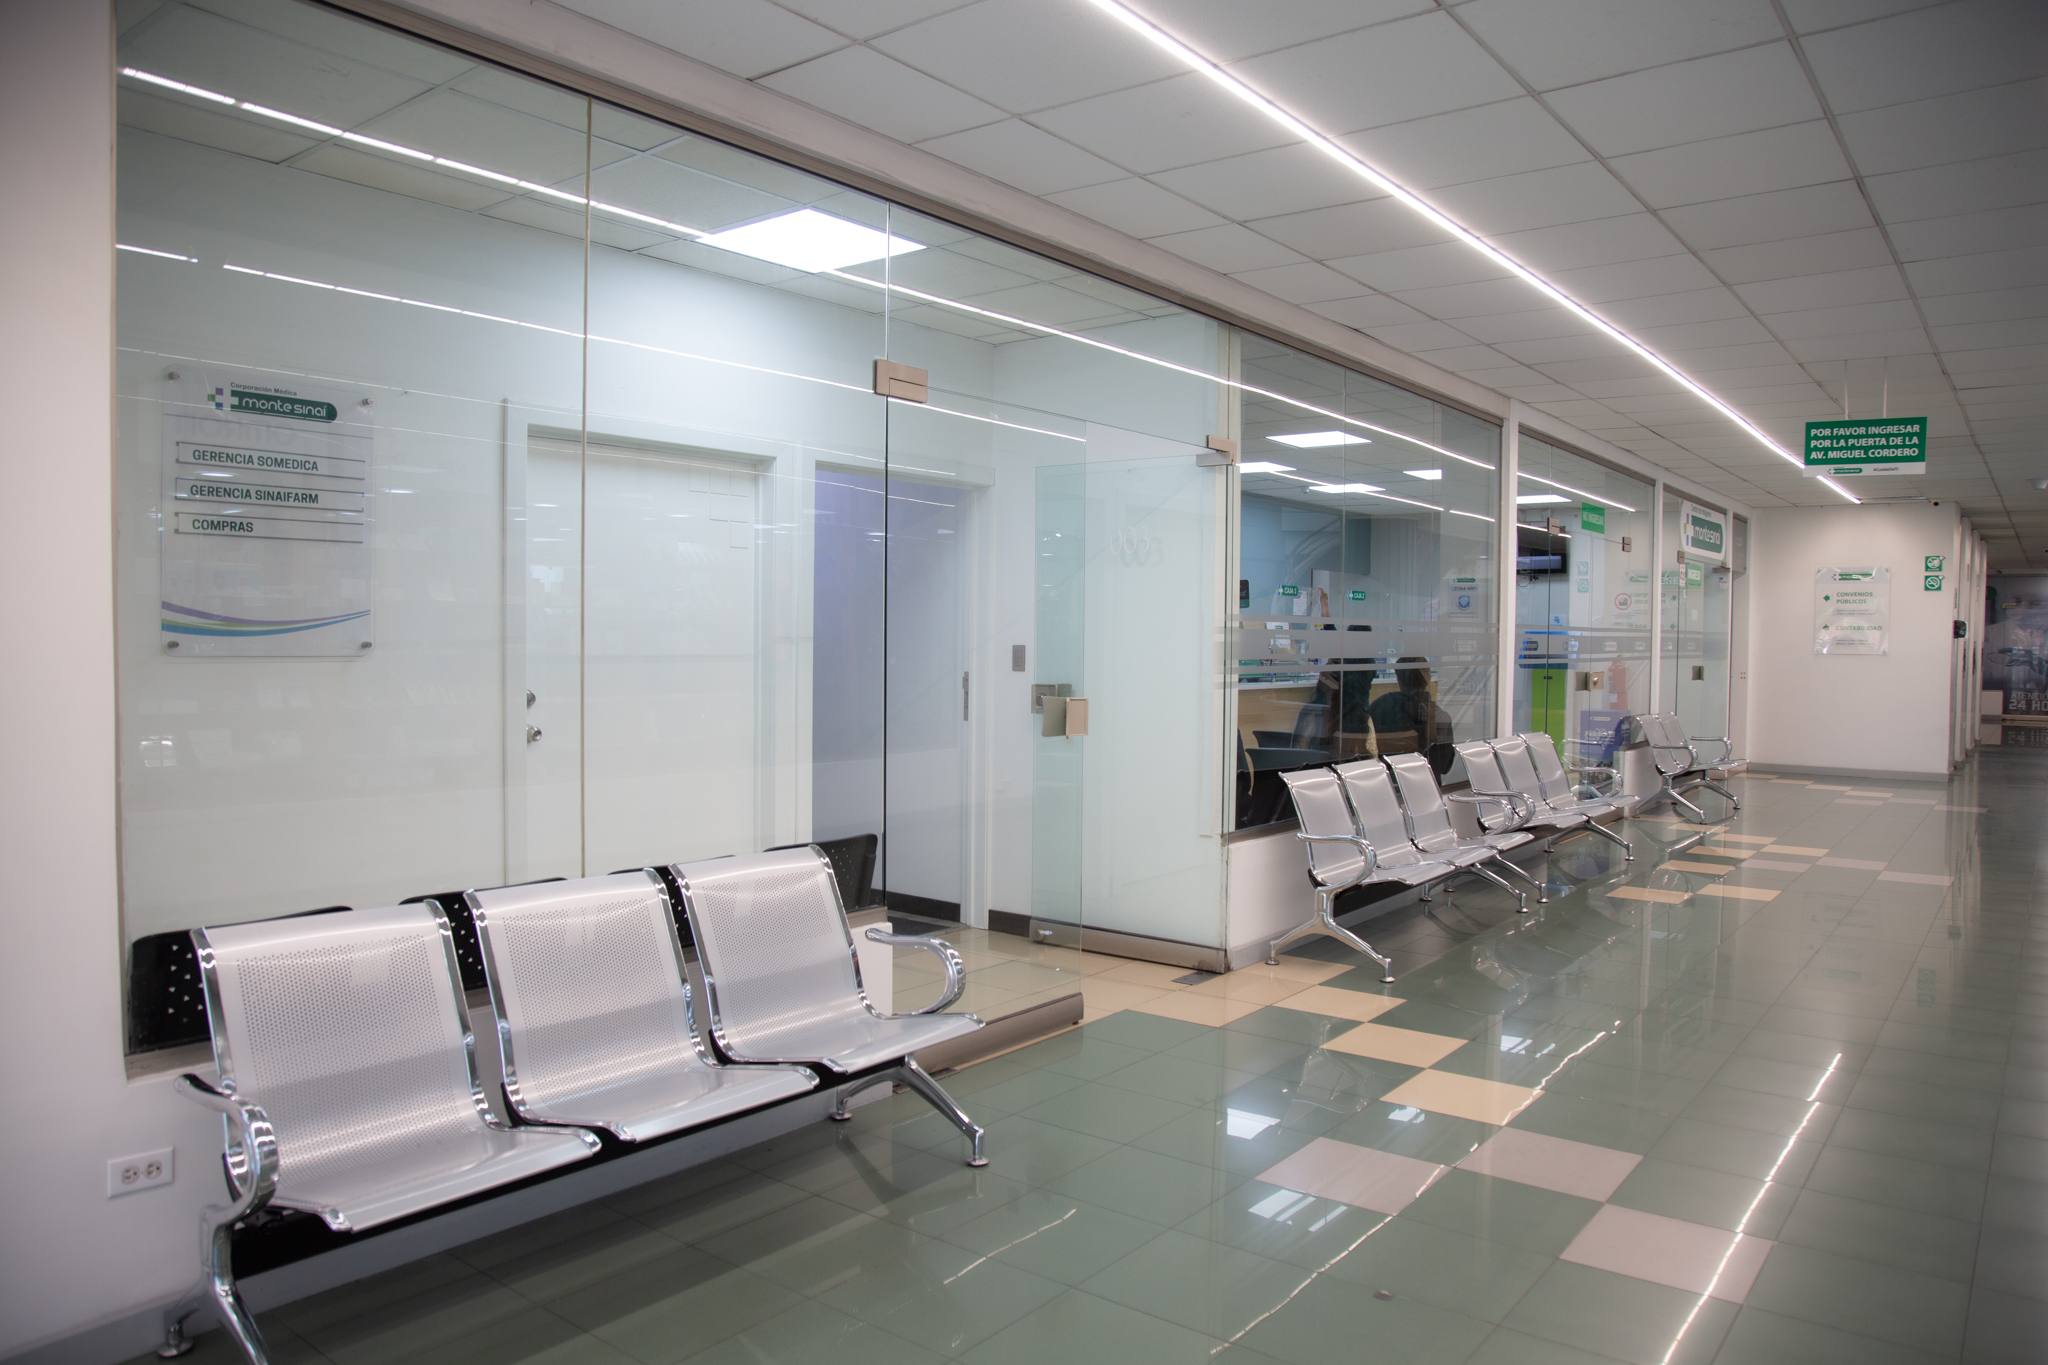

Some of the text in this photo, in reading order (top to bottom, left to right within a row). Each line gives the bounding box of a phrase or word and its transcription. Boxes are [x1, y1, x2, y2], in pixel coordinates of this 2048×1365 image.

[230, 382, 297, 396] Corporación Médica
[1810, 424, 1920, 437] POR FAVOR INGRESAR
[1810, 436, 1919, 448] POR LA PUERTA DE LA
[192, 449, 319, 471] GERENCIA SOMEDICA
[1810, 448, 1919, 459] AV. MIGUEL CORDERO
[190, 485, 318, 504] GERENCIA SINAIFARM
[192, 519, 254, 533] COMPRAS
[2009, 699, 2027, 711] 24
